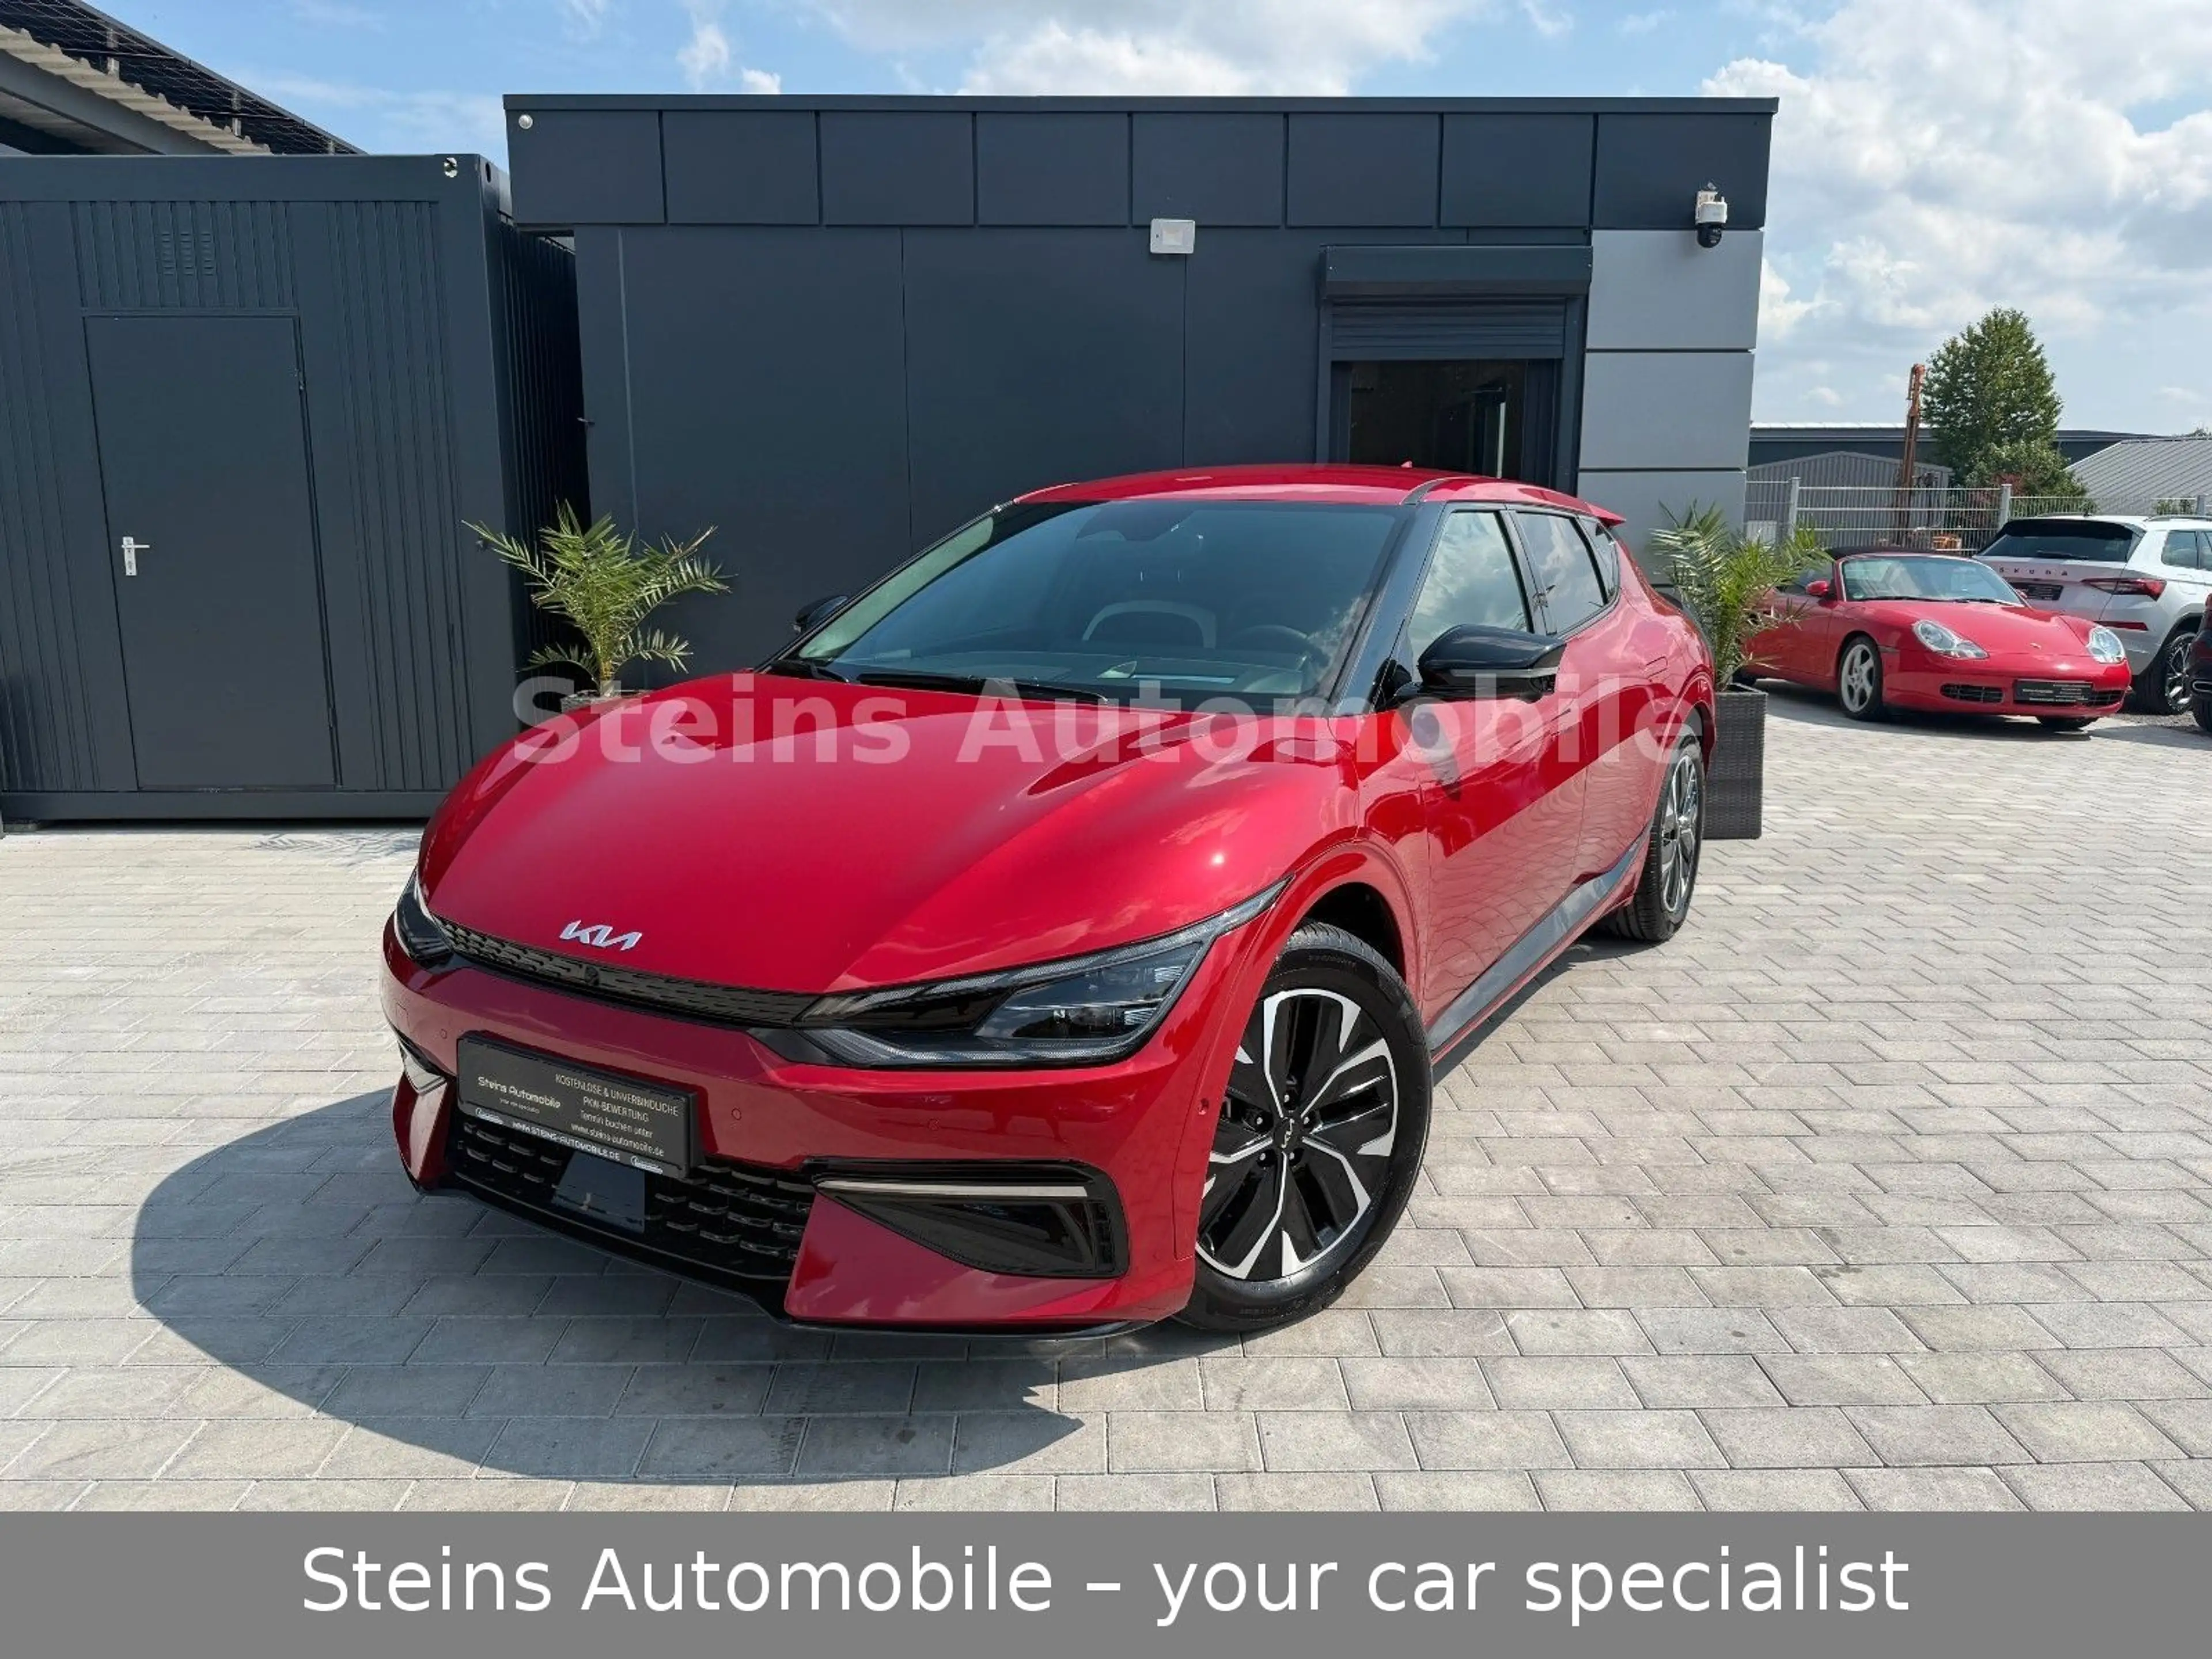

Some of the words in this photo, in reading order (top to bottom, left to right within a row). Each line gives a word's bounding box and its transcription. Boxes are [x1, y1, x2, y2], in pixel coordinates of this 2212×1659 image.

[478, 1076, 507, 1093] Steins
[509, 1085, 561, 1109] Automobile
[555, 1073, 602, 1096] KOSTENLOSE
[611, 1089, 679, 1116] UNVERBINDLICHE
[583, 1096, 649, 1122] PKW-BEWERTUNG
